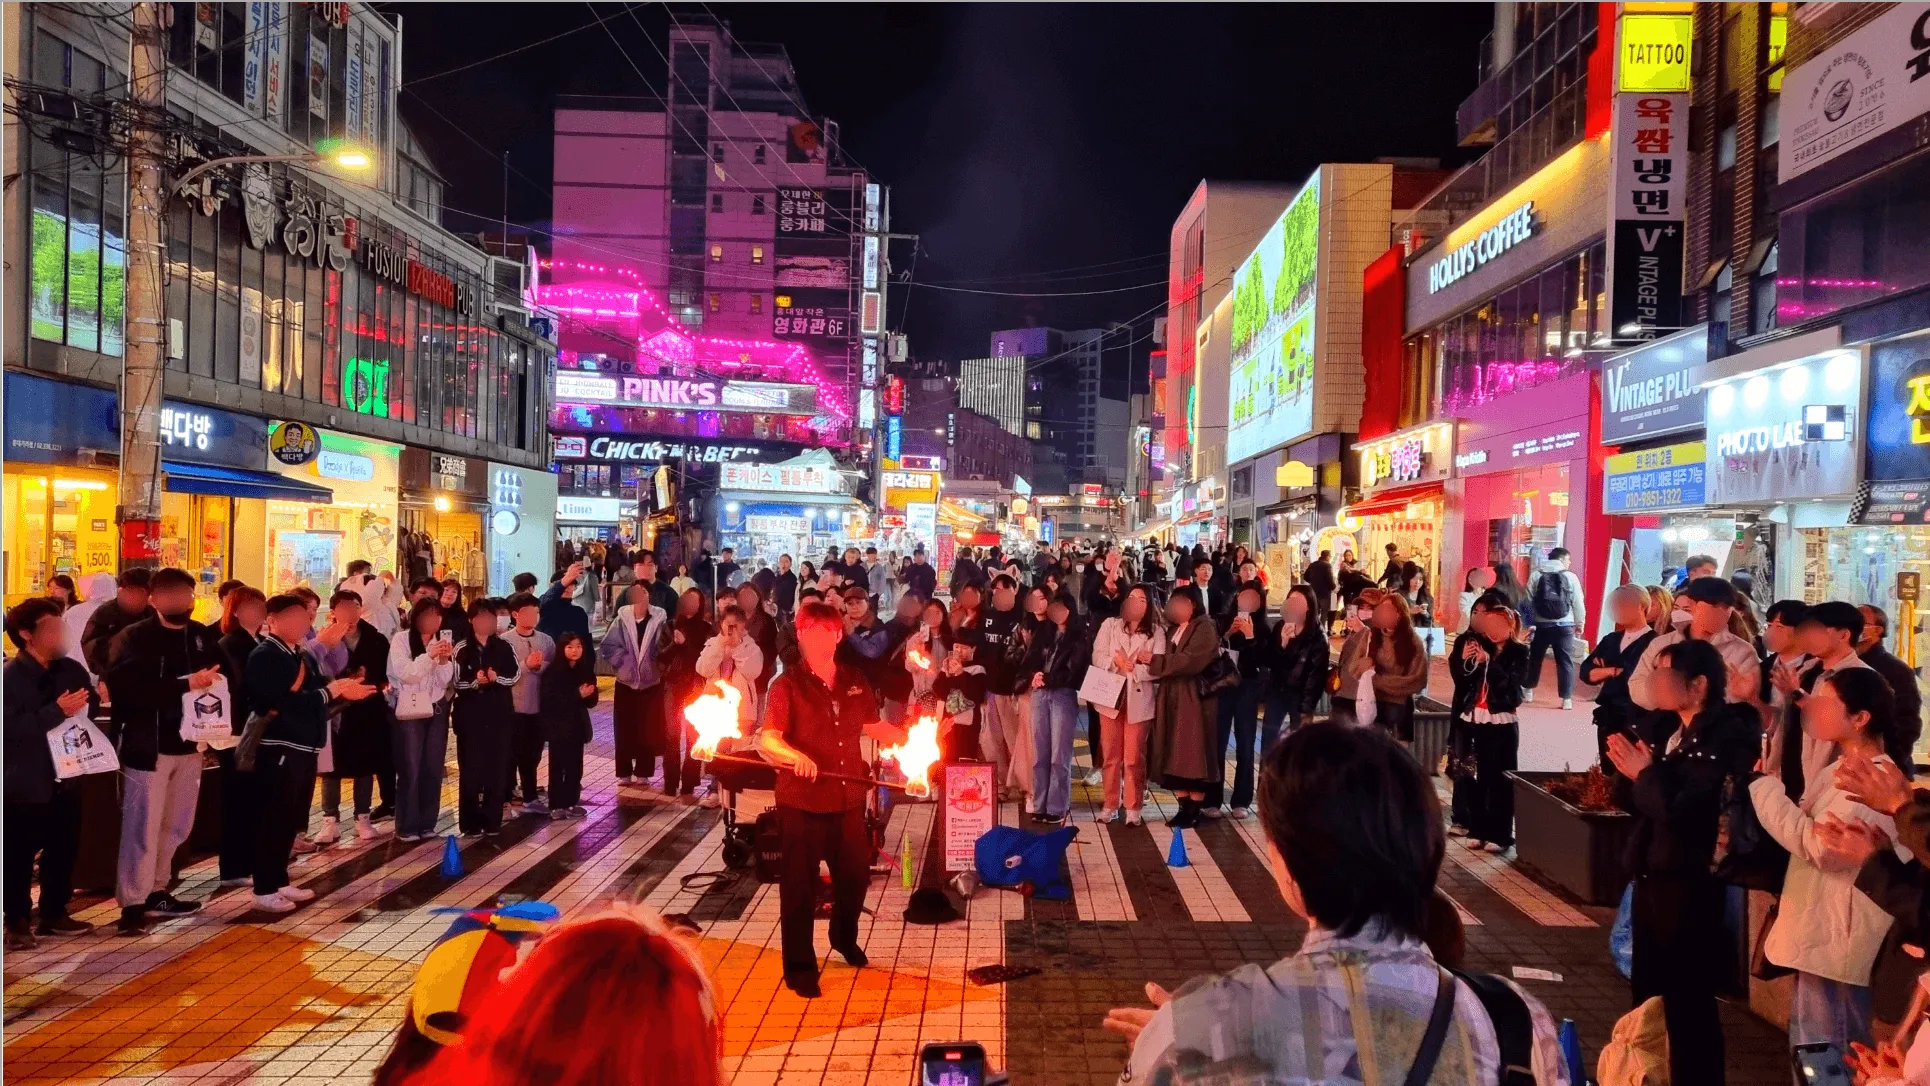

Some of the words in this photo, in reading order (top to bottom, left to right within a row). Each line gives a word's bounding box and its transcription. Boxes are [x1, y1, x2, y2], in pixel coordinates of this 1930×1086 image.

[313, 2, 343, 29] UB
[1628, 43, 1684, 65] TATTOO
[1632, 98, 1674, 215] 육쌈냉면
[1430, 239, 1475, 295] HOLLYS
[1477, 201, 1532, 264] COFFEE
[458, 280, 474, 318] PUB
[774, 317, 826, 335] 영화관
[828, 319, 844, 335] 6F
[624, 377, 716, 405] PINK'S
[1607, 365, 1663, 413] VINTAGE
[161, 408, 211, 450] 백다방
[1717, 426, 1769, 457] PHOTO
[281, 453, 303, 461] 백다방
[590, 437, 684, 460] CHICKEN
[726, 467, 772, 483] 폰케이스
[781, 470, 824, 486] 필름부착
